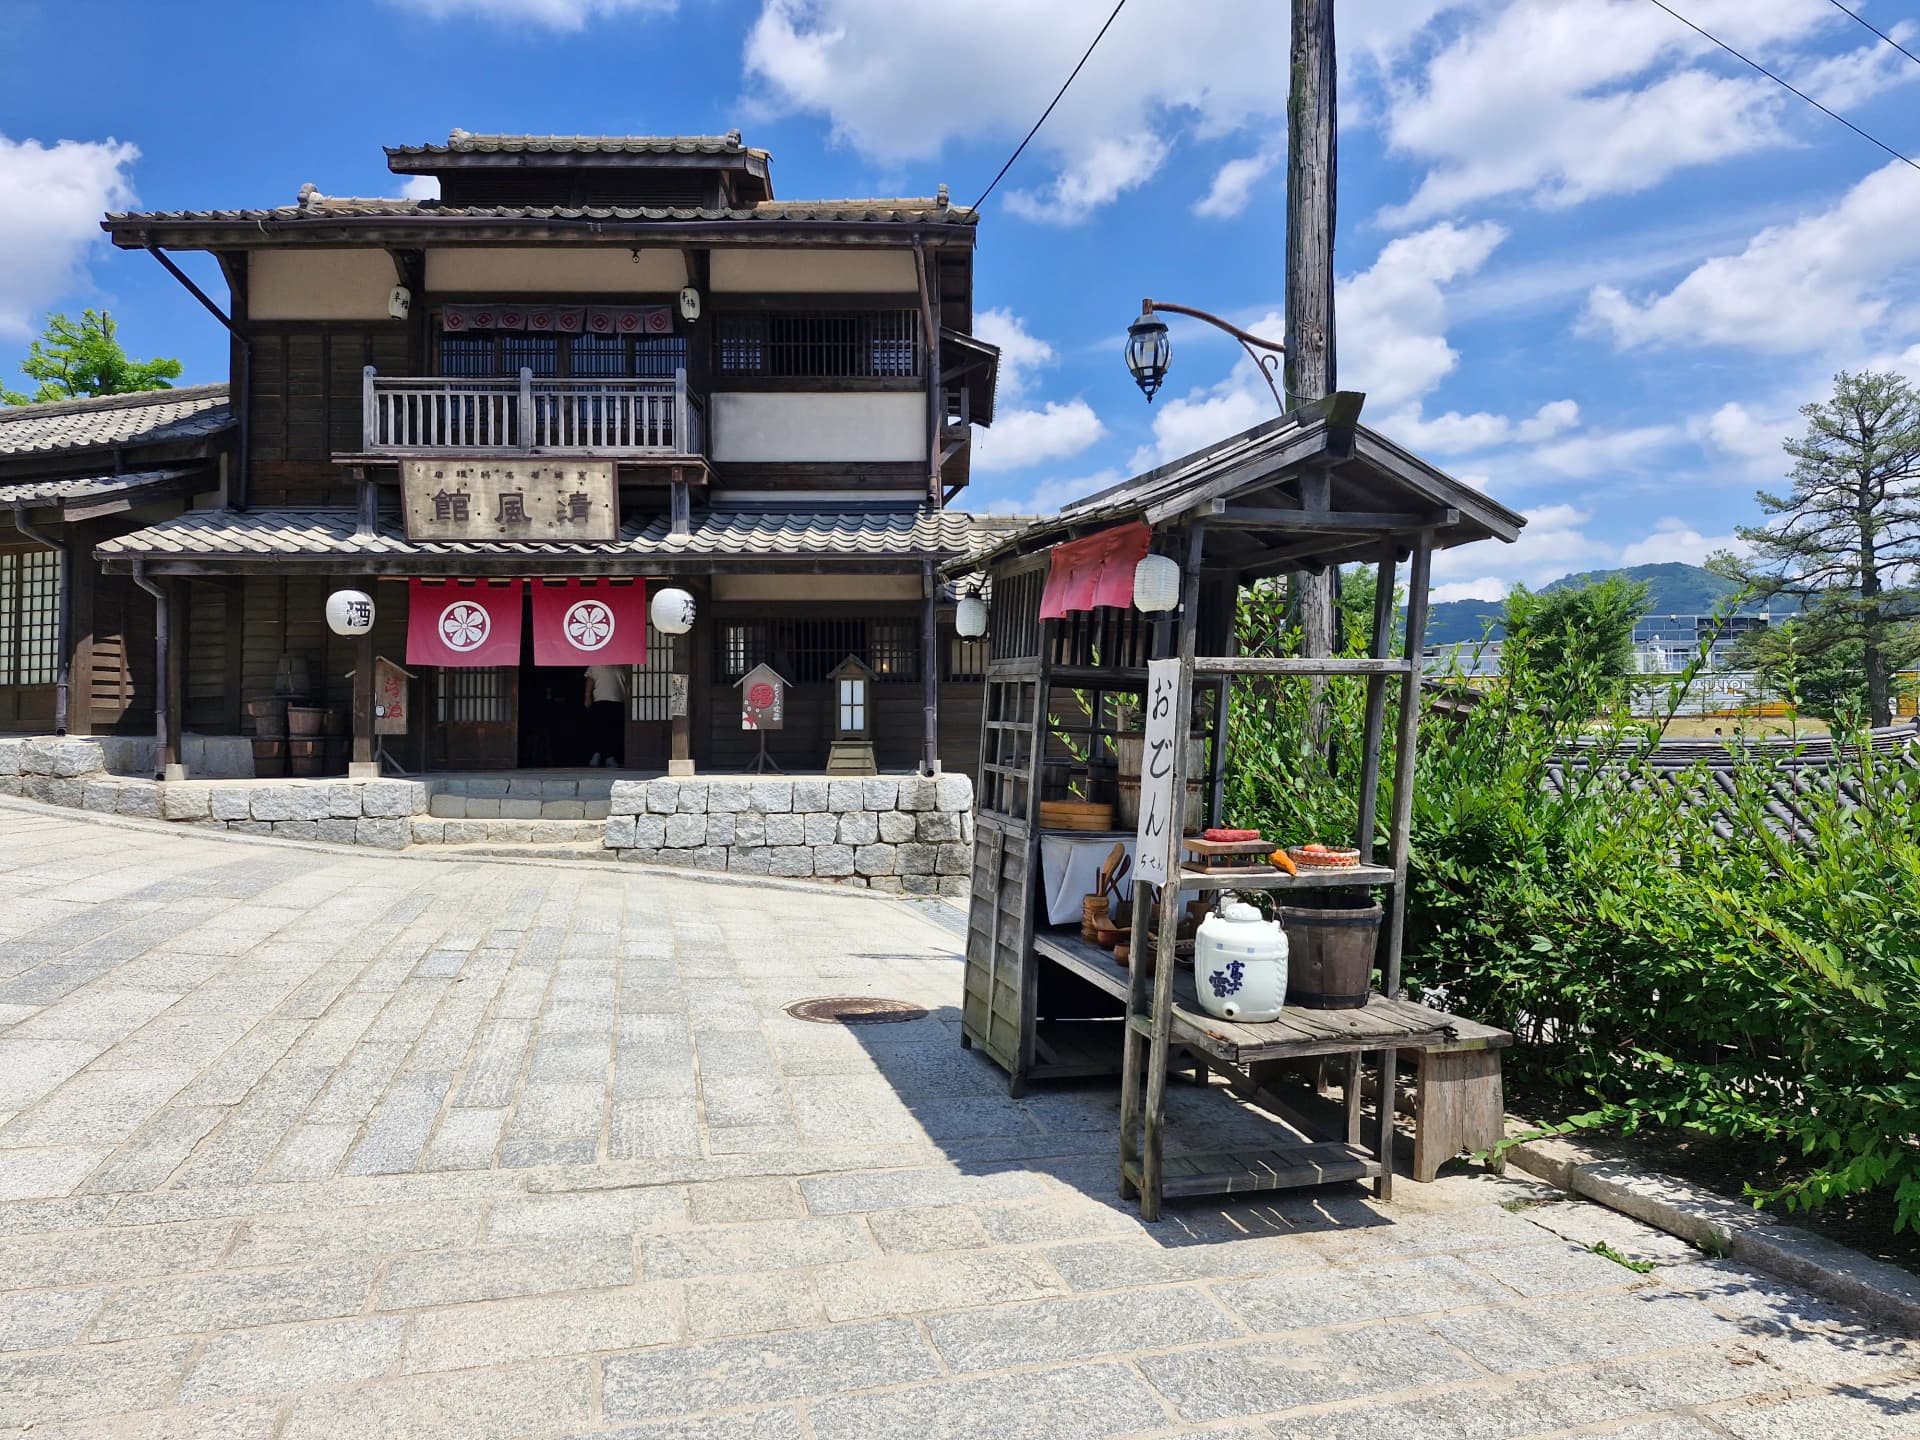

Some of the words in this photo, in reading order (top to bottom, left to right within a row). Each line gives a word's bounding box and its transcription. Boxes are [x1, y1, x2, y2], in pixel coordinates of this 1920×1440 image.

[432, 488, 593, 524] 清風館
[346, 600, 370, 627] 酒
[1145, 677, 1173, 837] おでん
